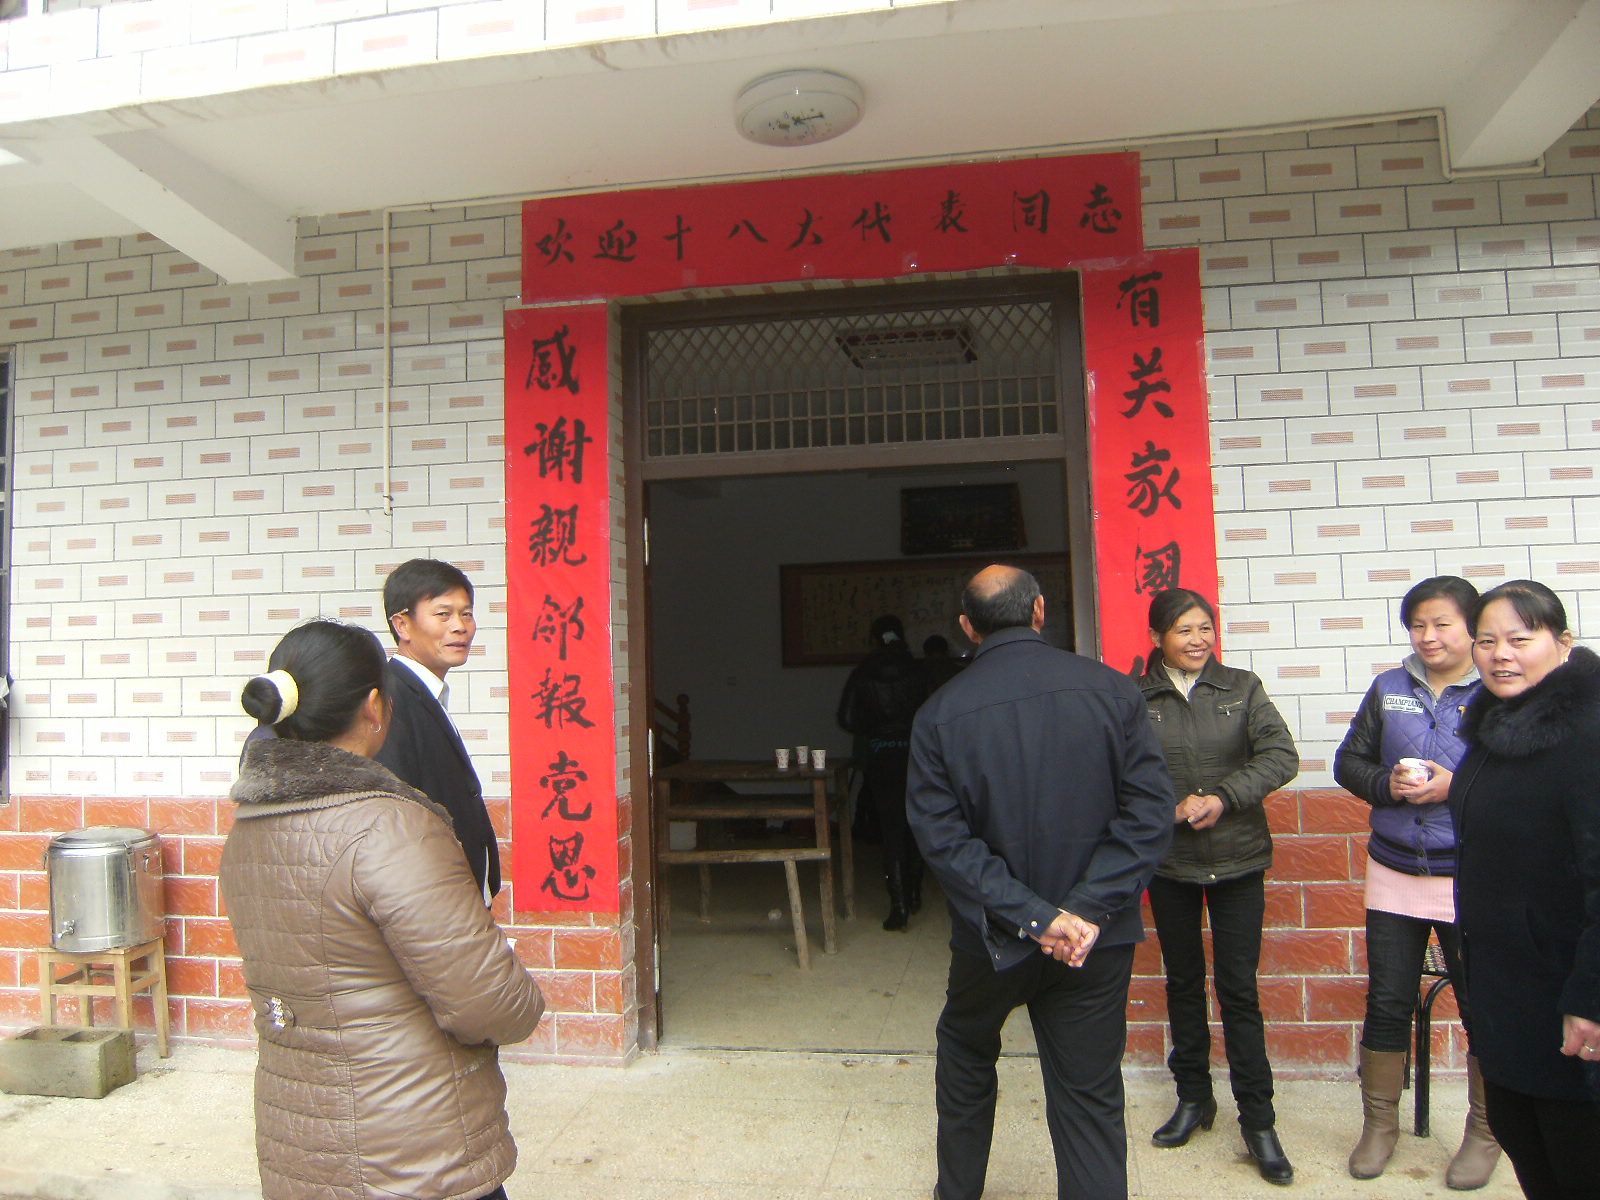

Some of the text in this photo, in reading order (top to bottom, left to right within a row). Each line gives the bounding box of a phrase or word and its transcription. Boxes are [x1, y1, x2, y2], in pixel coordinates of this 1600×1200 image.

[535, 183, 1122, 267] 欢迎十八大代表同志
